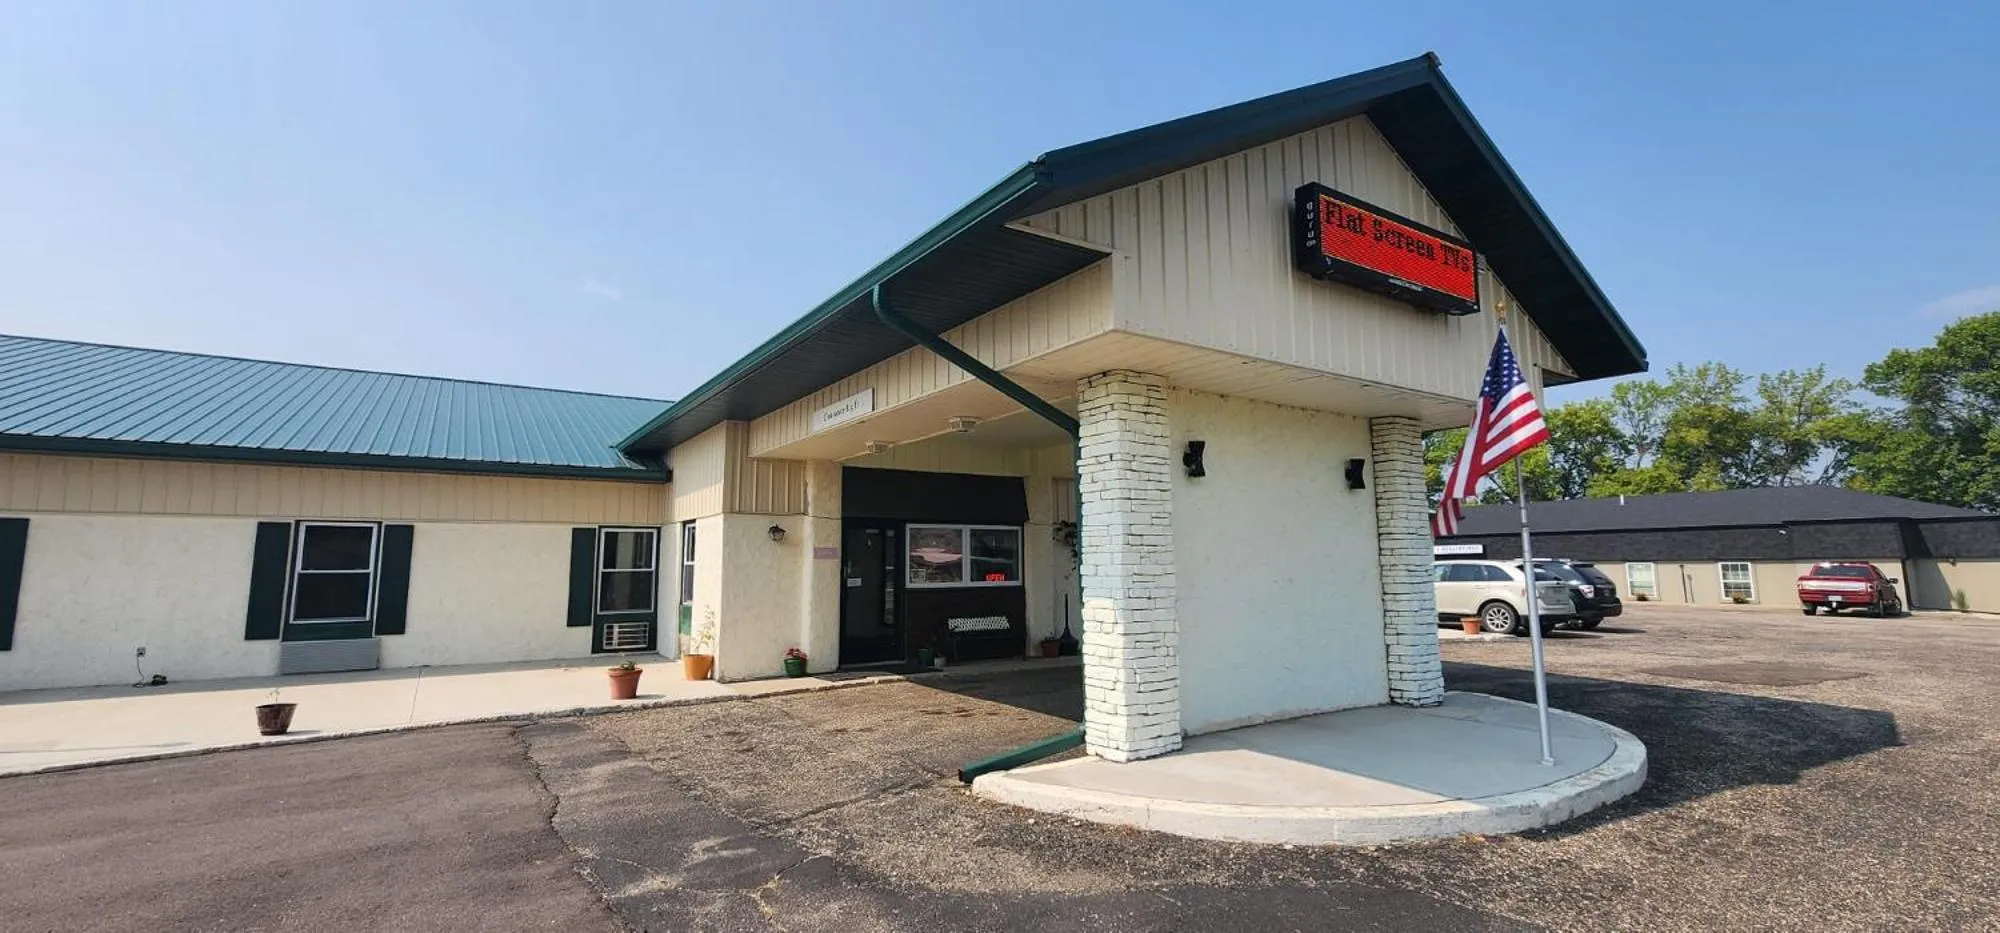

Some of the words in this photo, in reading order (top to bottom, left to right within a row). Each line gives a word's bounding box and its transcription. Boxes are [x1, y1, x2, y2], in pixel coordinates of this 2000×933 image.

[1325, 200, 1365, 237] Flat
[1373, 217, 1436, 261] Screen
[1440, 243, 1470, 272] TVs
